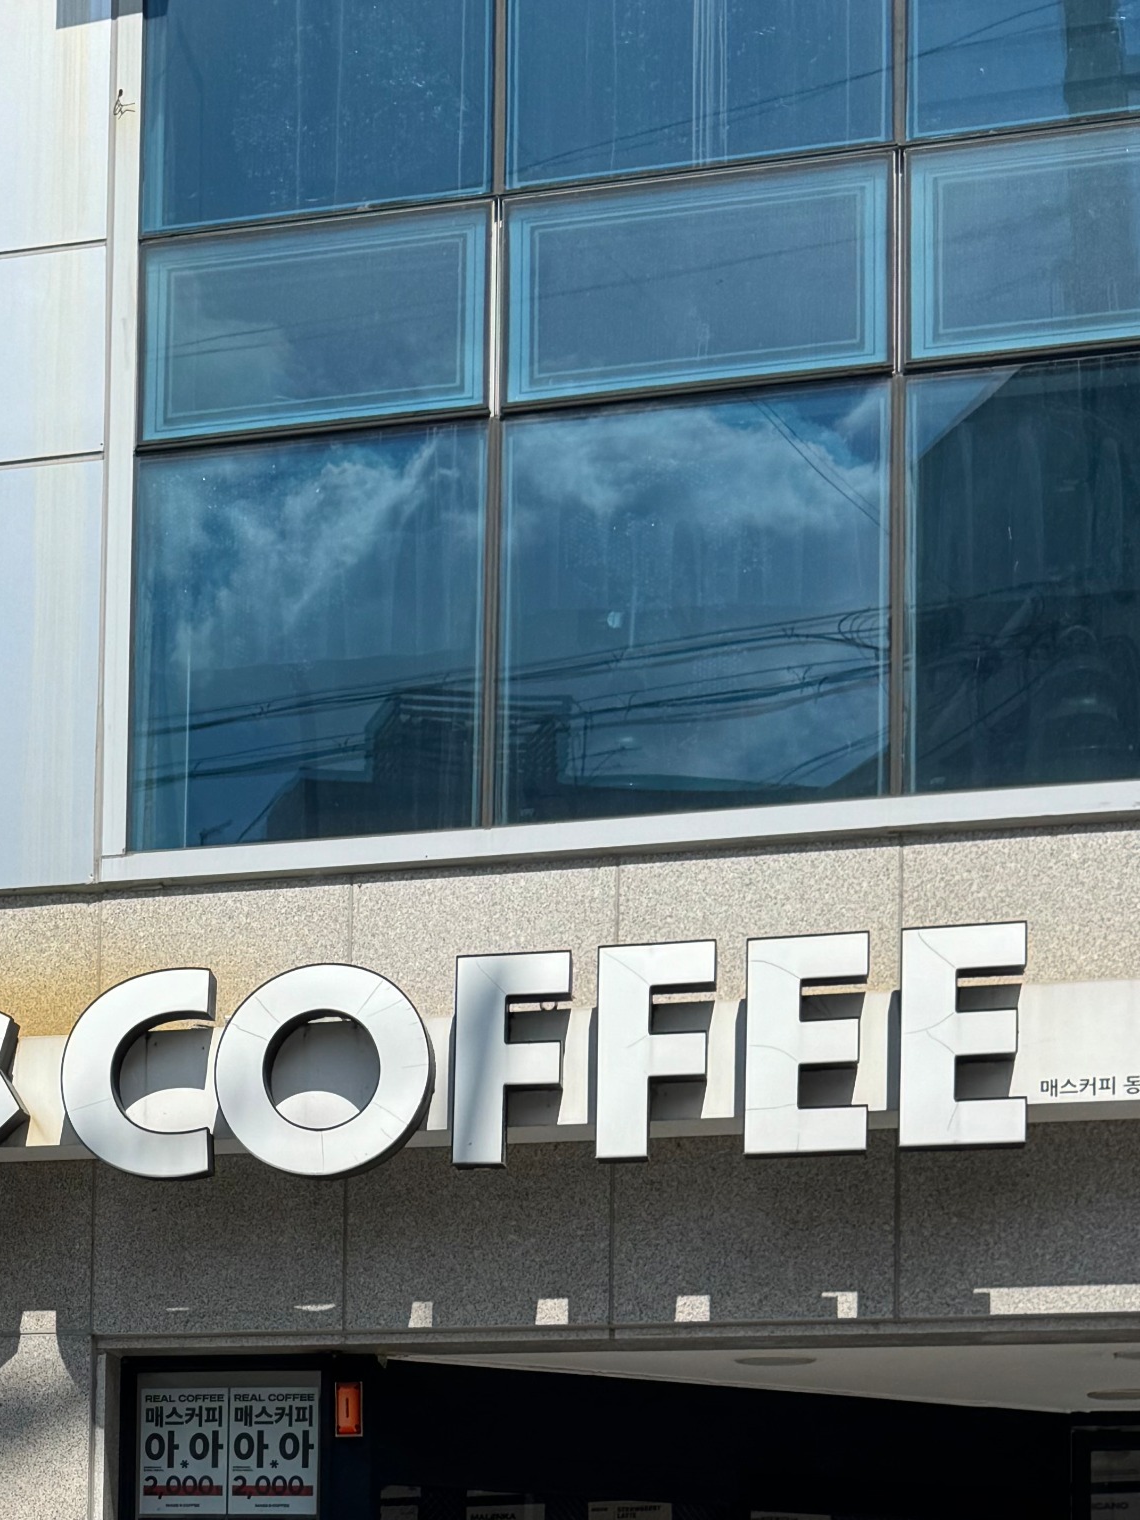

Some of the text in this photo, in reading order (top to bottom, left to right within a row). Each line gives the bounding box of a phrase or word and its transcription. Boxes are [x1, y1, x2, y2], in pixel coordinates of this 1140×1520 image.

[60, 920, 1029, 1180] COFFEE
[1040, 1076, 1116, 1097] 매스커피
[145, 1394, 225, 1403] REAL COFFEE
[234, 1393, 315, 1402] REAL COFFEE
[145, 1405, 222, 1427] 매스커피
[234, 1405, 313, 1427] 매스커피
